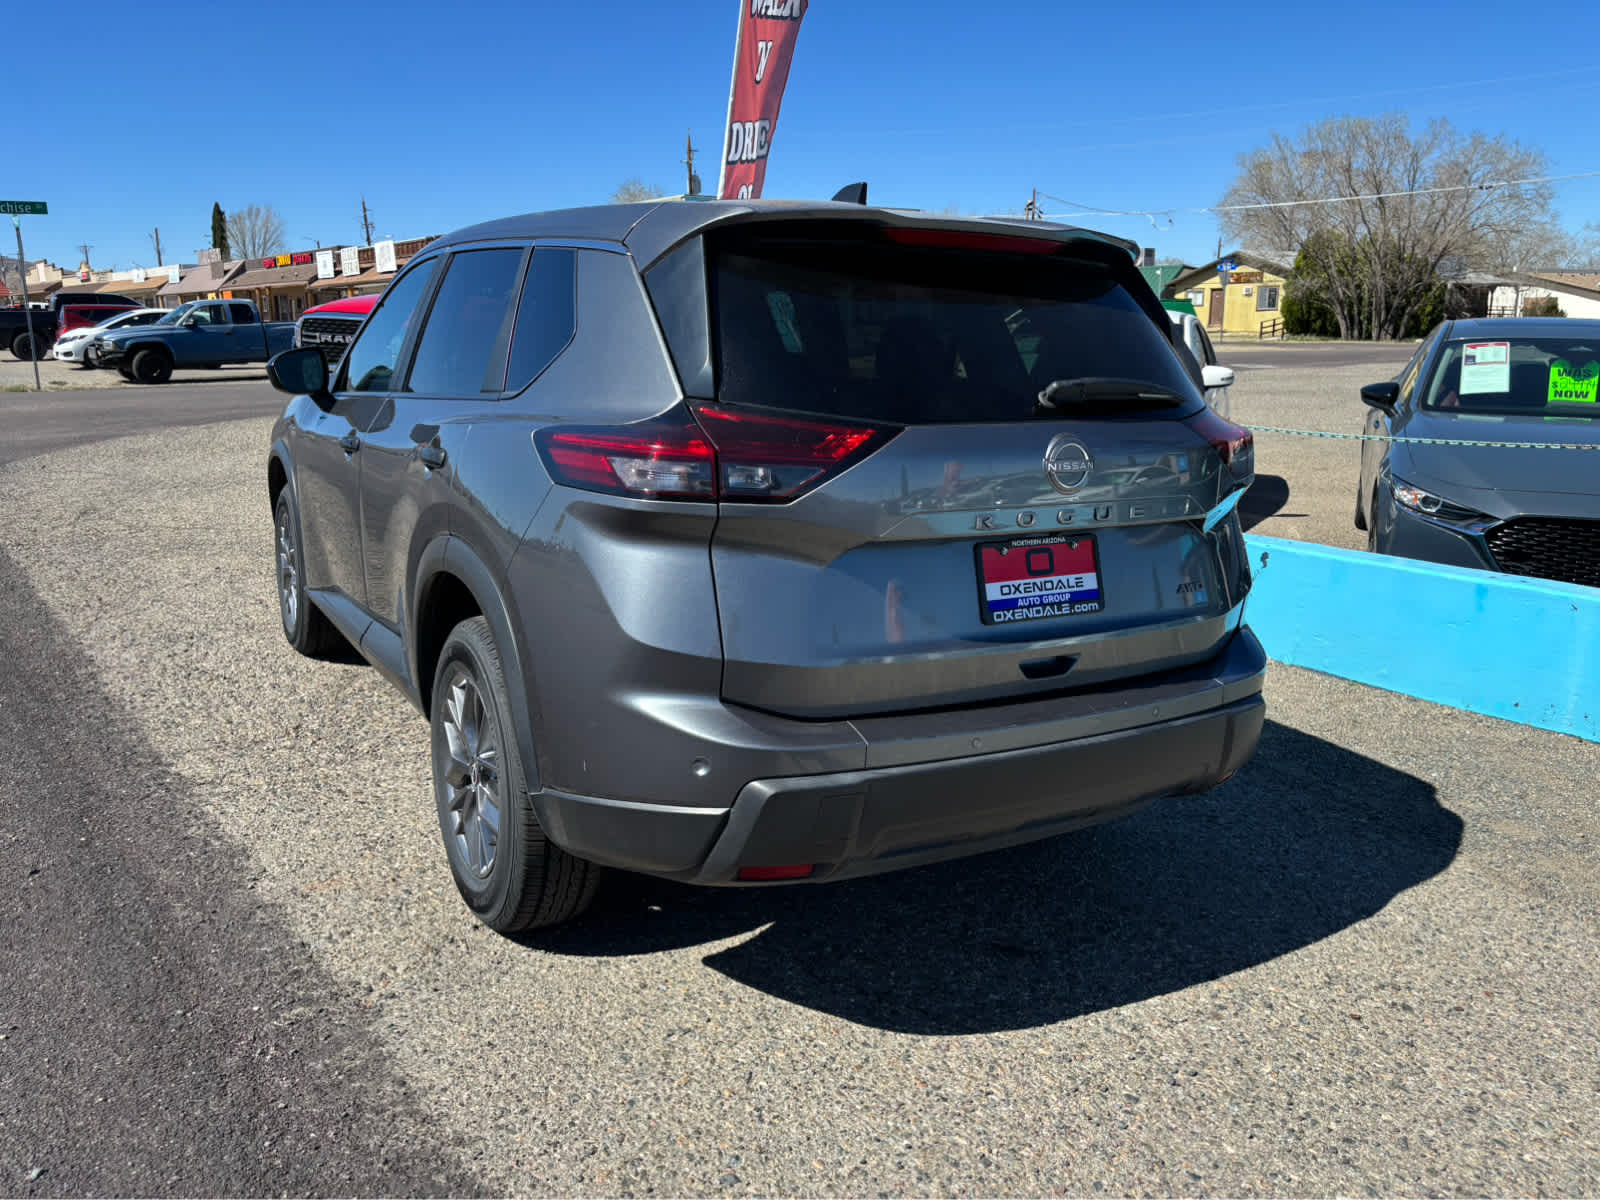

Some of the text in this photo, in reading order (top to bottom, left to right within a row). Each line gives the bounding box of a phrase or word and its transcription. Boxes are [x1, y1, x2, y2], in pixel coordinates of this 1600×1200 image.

[1558, 367, 1593, 378] WAS
[1554, 389, 1590, 399] NOW
[1048, 462, 1094, 471] NISSAN
[975, 505, 1146, 530] ROGUE
[1011, 536, 1066, 547] NORTHERN ARIZONA
[1000, 577, 1085, 597] OXENDALE
[1017, 593, 1071, 607] AUTO GROUP
[993, 601, 1099, 623] OXENDALE.com
